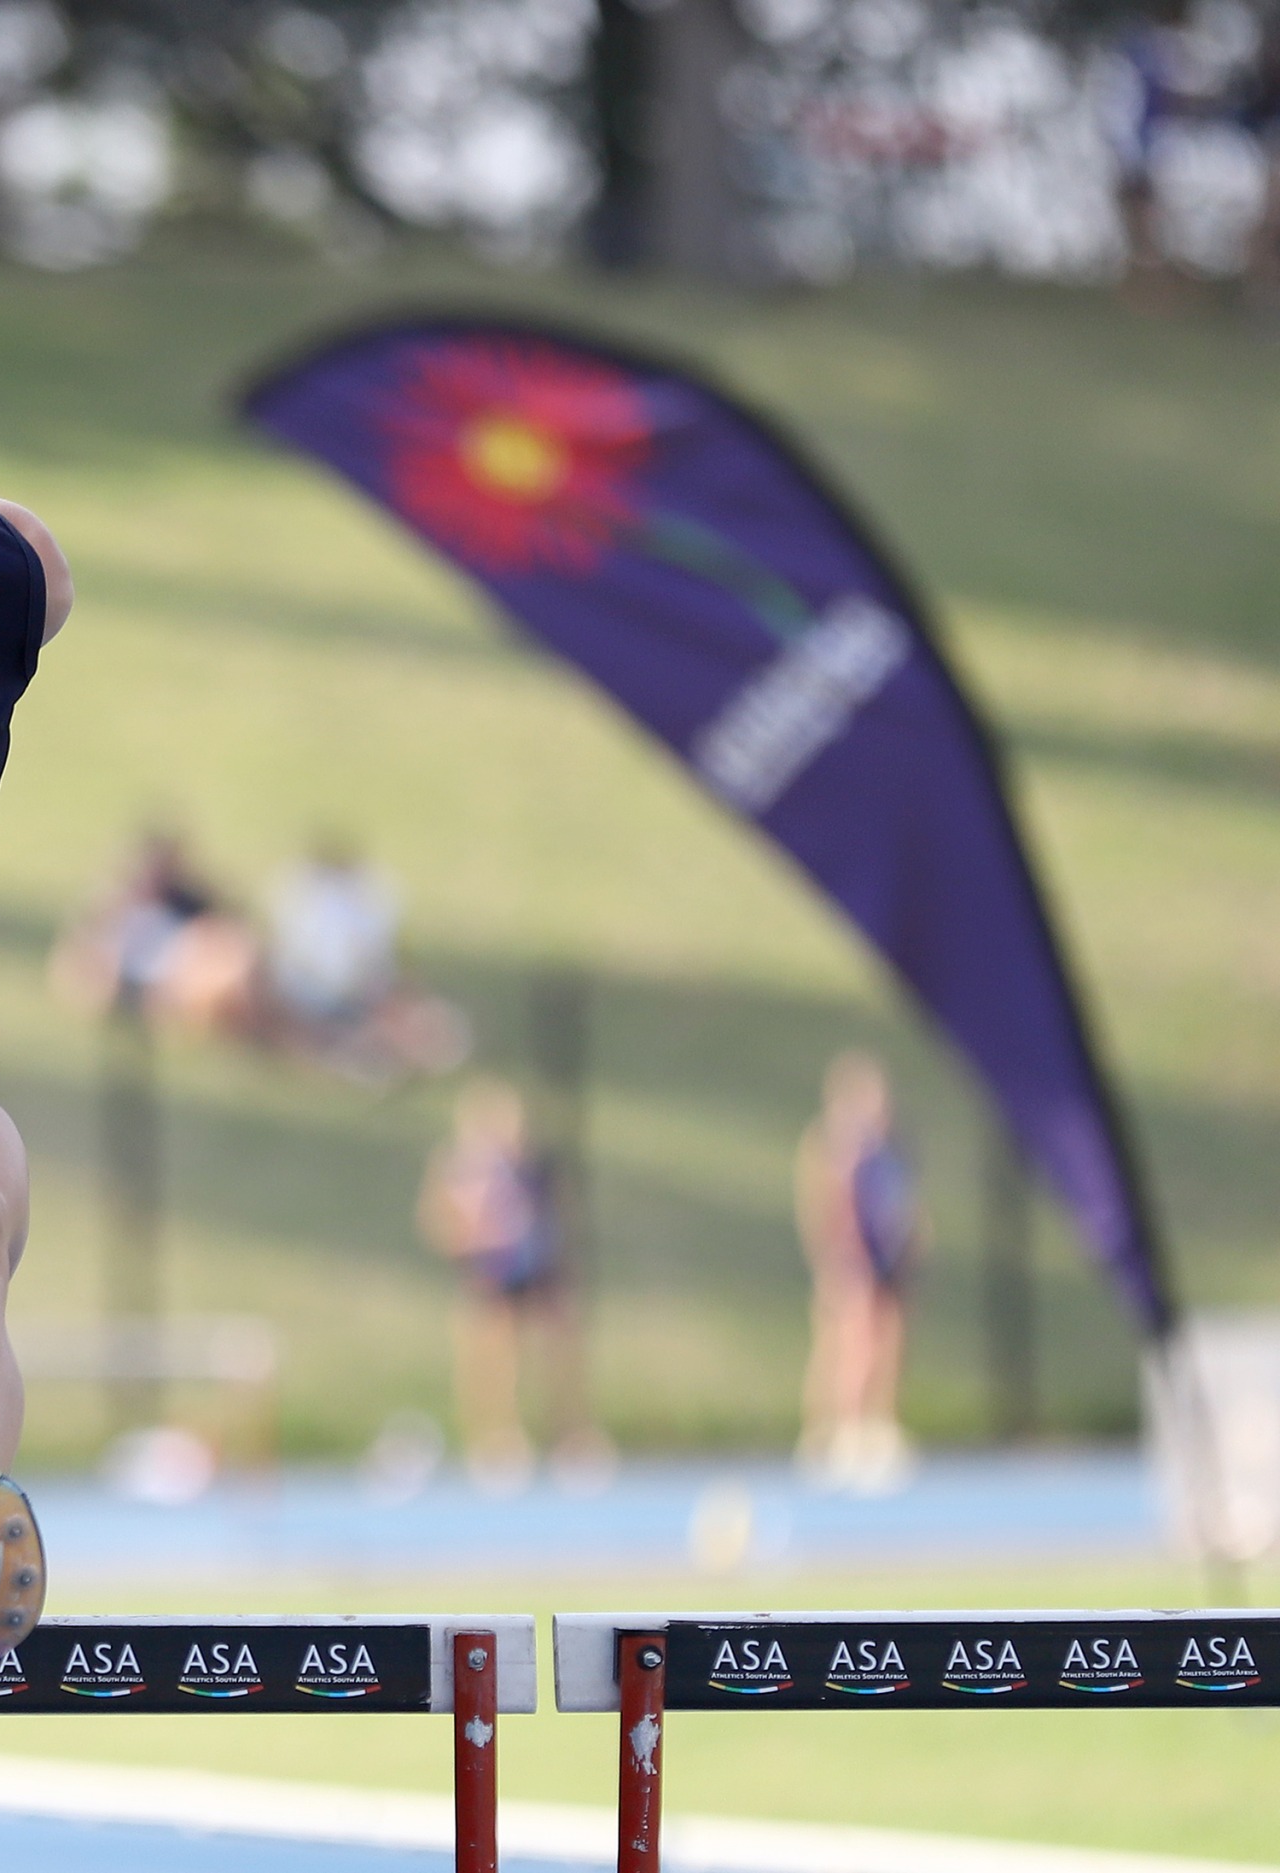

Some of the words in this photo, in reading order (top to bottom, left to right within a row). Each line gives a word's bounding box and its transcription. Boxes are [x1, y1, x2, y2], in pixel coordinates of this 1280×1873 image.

[66, 1644, 140, 1673] ASA
[184, 1644, 257, 1673] ASA
[301, 1645, 375, 1674] ASA
[715, 1640, 787, 1670] ASA
[831, 1641, 904, 1670] ASA
[948, 1641, 1021, 1670] ASA
[1065, 1639, 1138, 1669] ASA
[1181, 1638, 1254, 1667] ASA
